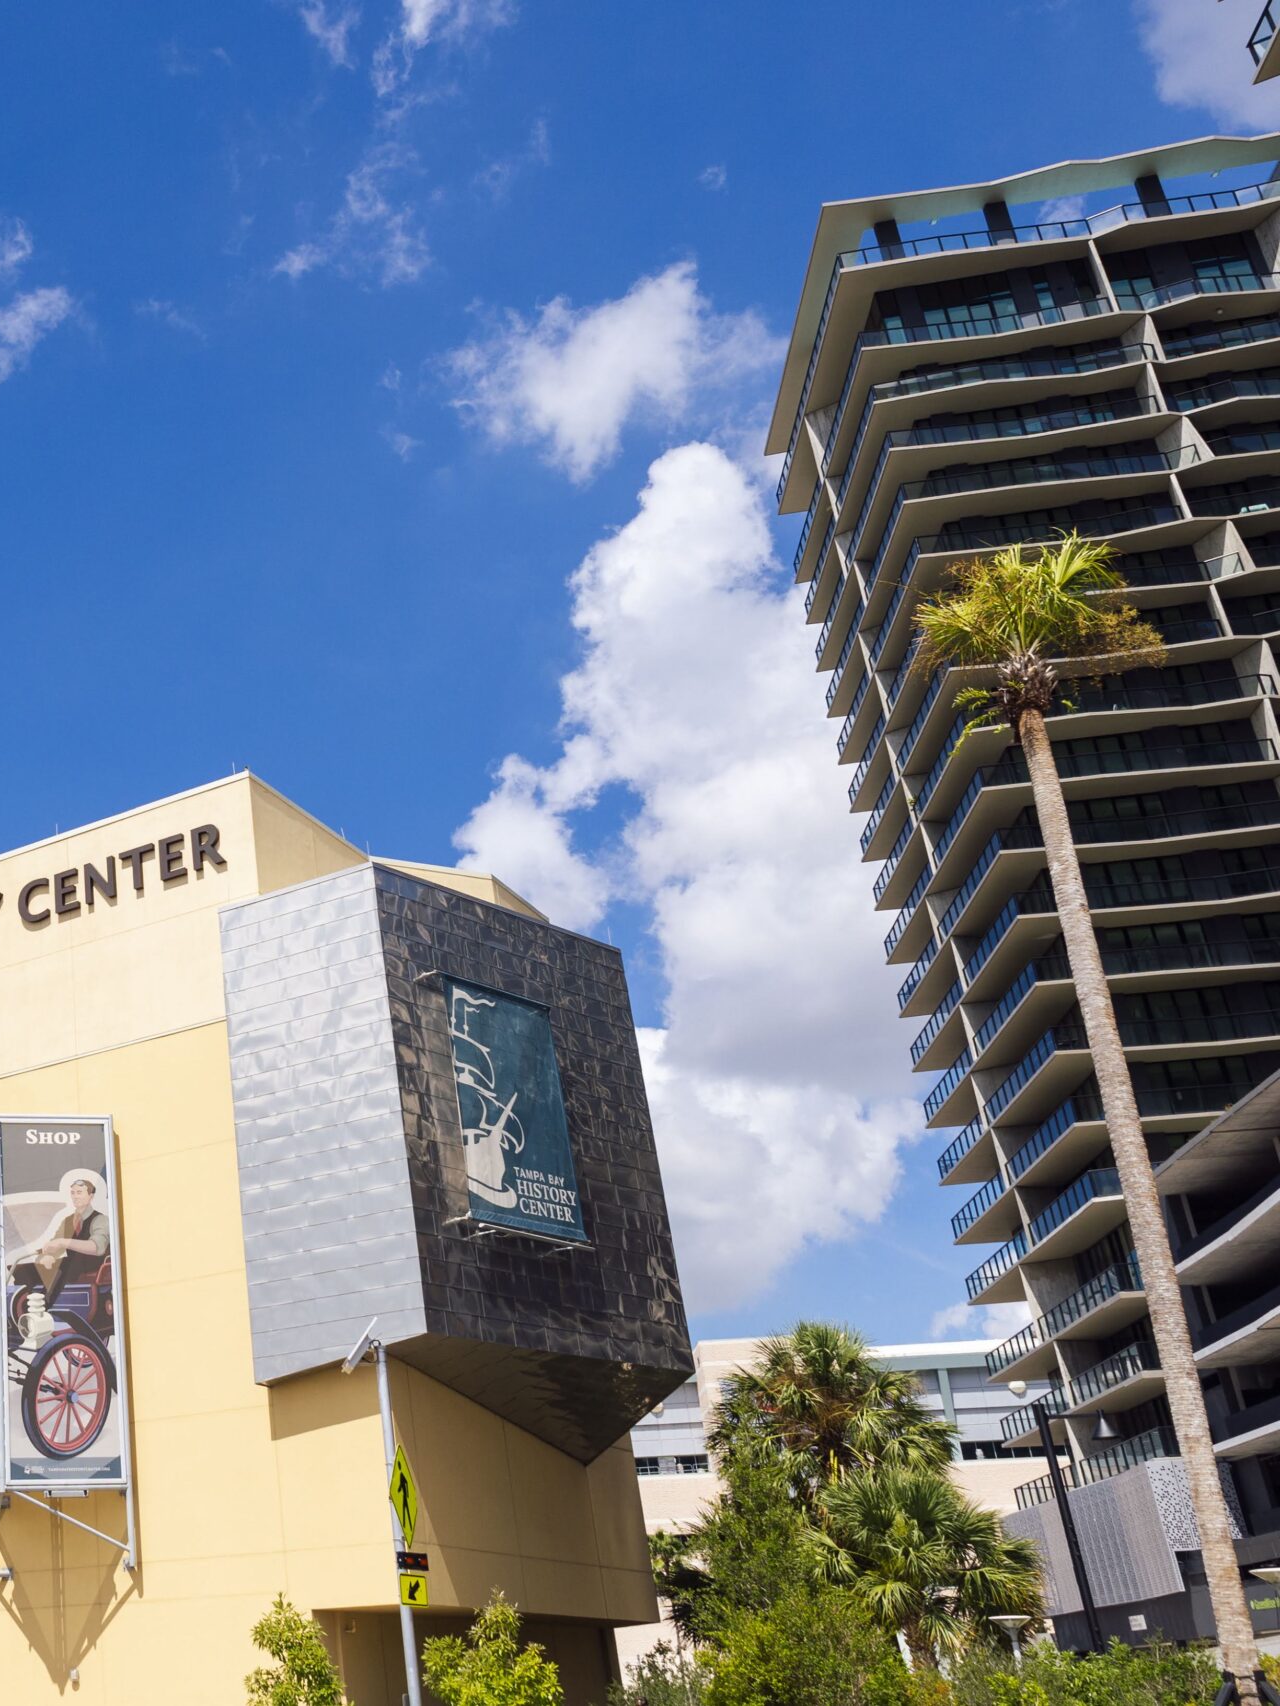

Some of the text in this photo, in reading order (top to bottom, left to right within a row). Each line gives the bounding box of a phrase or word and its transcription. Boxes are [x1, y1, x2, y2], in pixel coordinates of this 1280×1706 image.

[18, 823, 228, 926] CENTER
[25, 1128, 81, 1145] SHOP
[512, 1166, 565, 1187] TAMPA BAY
[515, 1179, 577, 1207] HISTORY
[519, 1197, 576, 1224] CENTER
